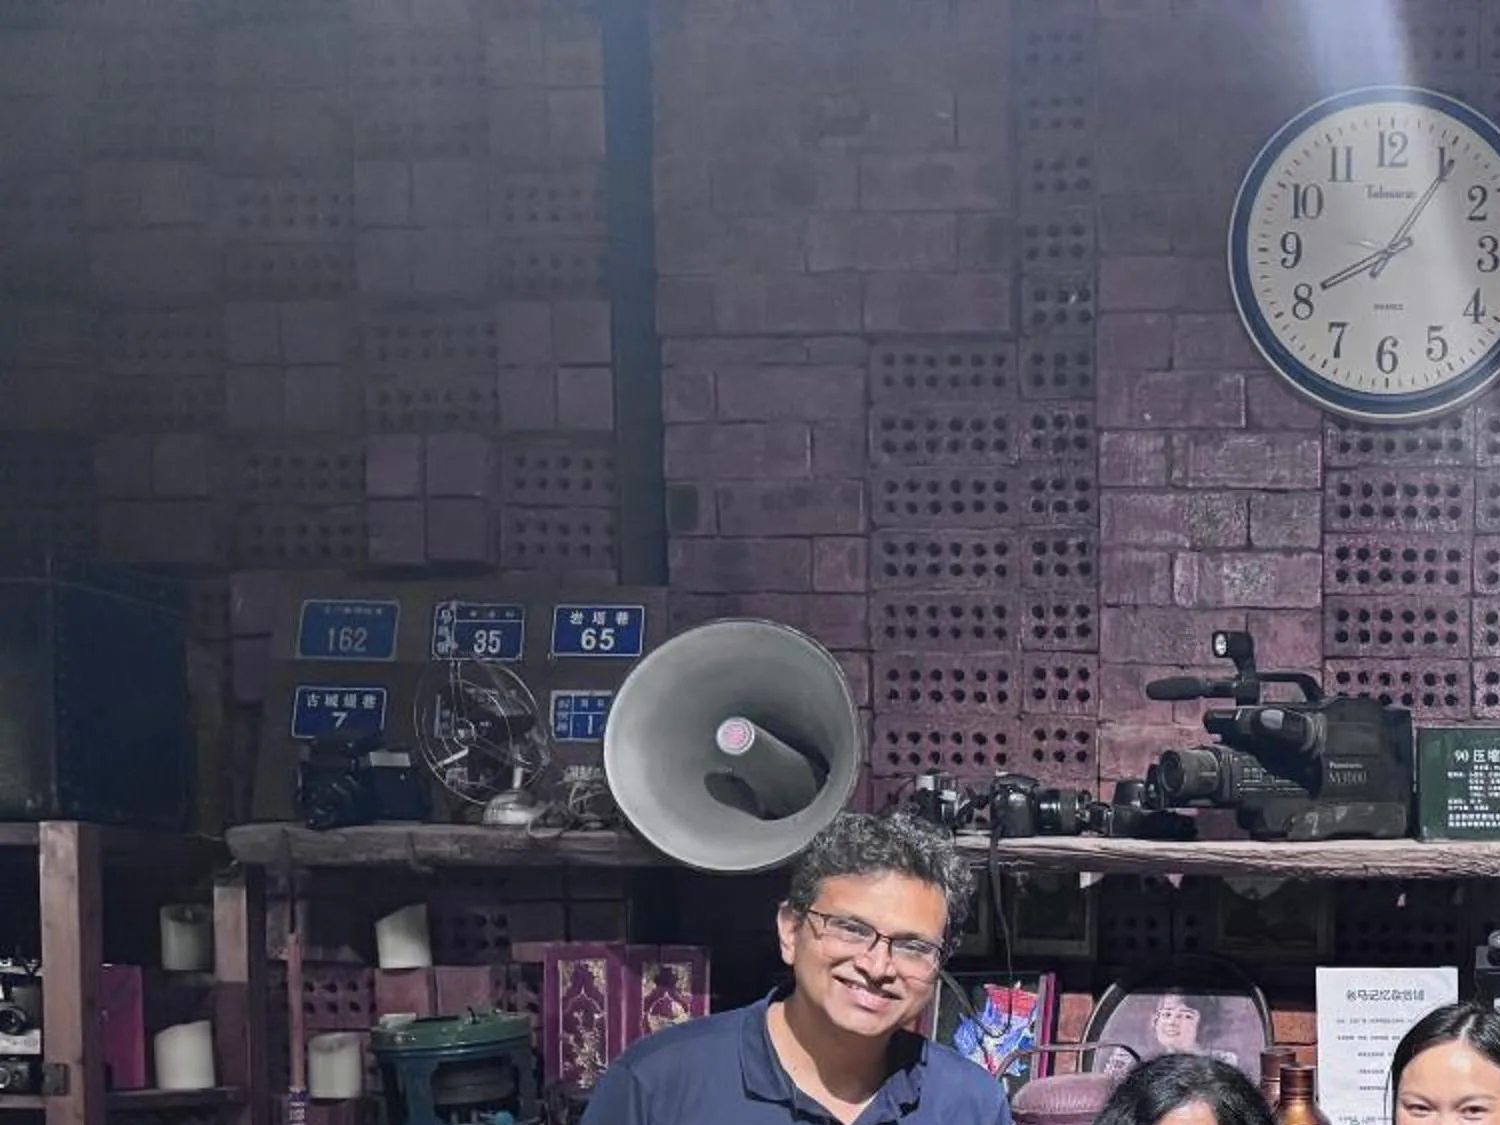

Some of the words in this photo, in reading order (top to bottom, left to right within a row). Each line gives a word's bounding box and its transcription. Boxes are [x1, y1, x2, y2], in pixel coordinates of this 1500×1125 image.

[1327, 146, 1354, 183] 11
[1377, 131, 1409, 168] 12
[1438, 146, 1449, 183] 1
[1291, 183, 1323, 220] 10
[1467, 185, 1489, 221] 2
[1280, 232, 1302, 269] 9
[1477, 235, 1500, 273] 3
[1292, 283, 1314, 320] 8
[1463, 288, 1486, 324] 4
[1327, 321, 1349, 359] 7
[1375, 336, 1399, 374] 6
[1425, 325, 1448, 362] 5
[328, 627, 368, 653] 162
[473, 629, 503, 654] 35
[581, 628, 615, 651] 65
[332, 711, 347, 728] 7
